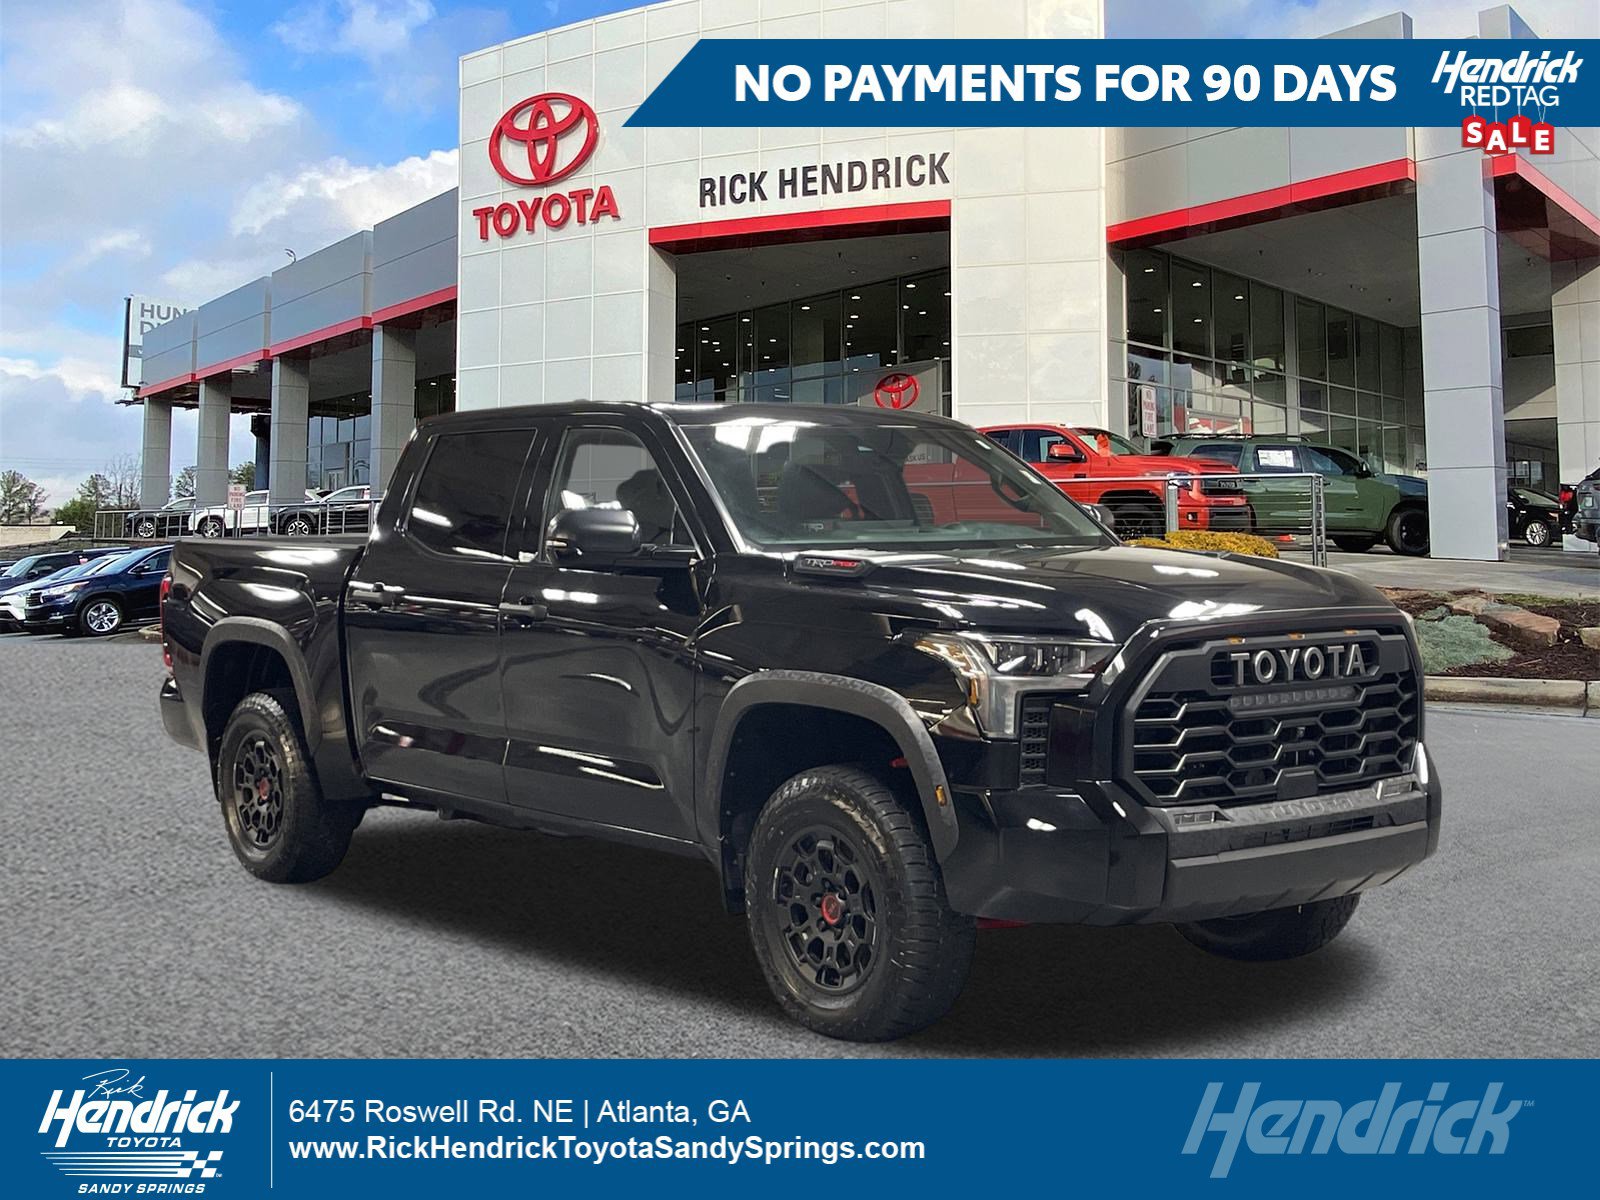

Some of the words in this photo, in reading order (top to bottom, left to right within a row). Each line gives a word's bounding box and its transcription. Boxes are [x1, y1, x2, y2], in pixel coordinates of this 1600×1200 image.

[699, 170, 768, 208] RICK
[778, 152, 951, 200] HENDRICK
[472, 184, 621, 242] TOYOTA
[1230, 643, 1366, 685] TOYOTA
